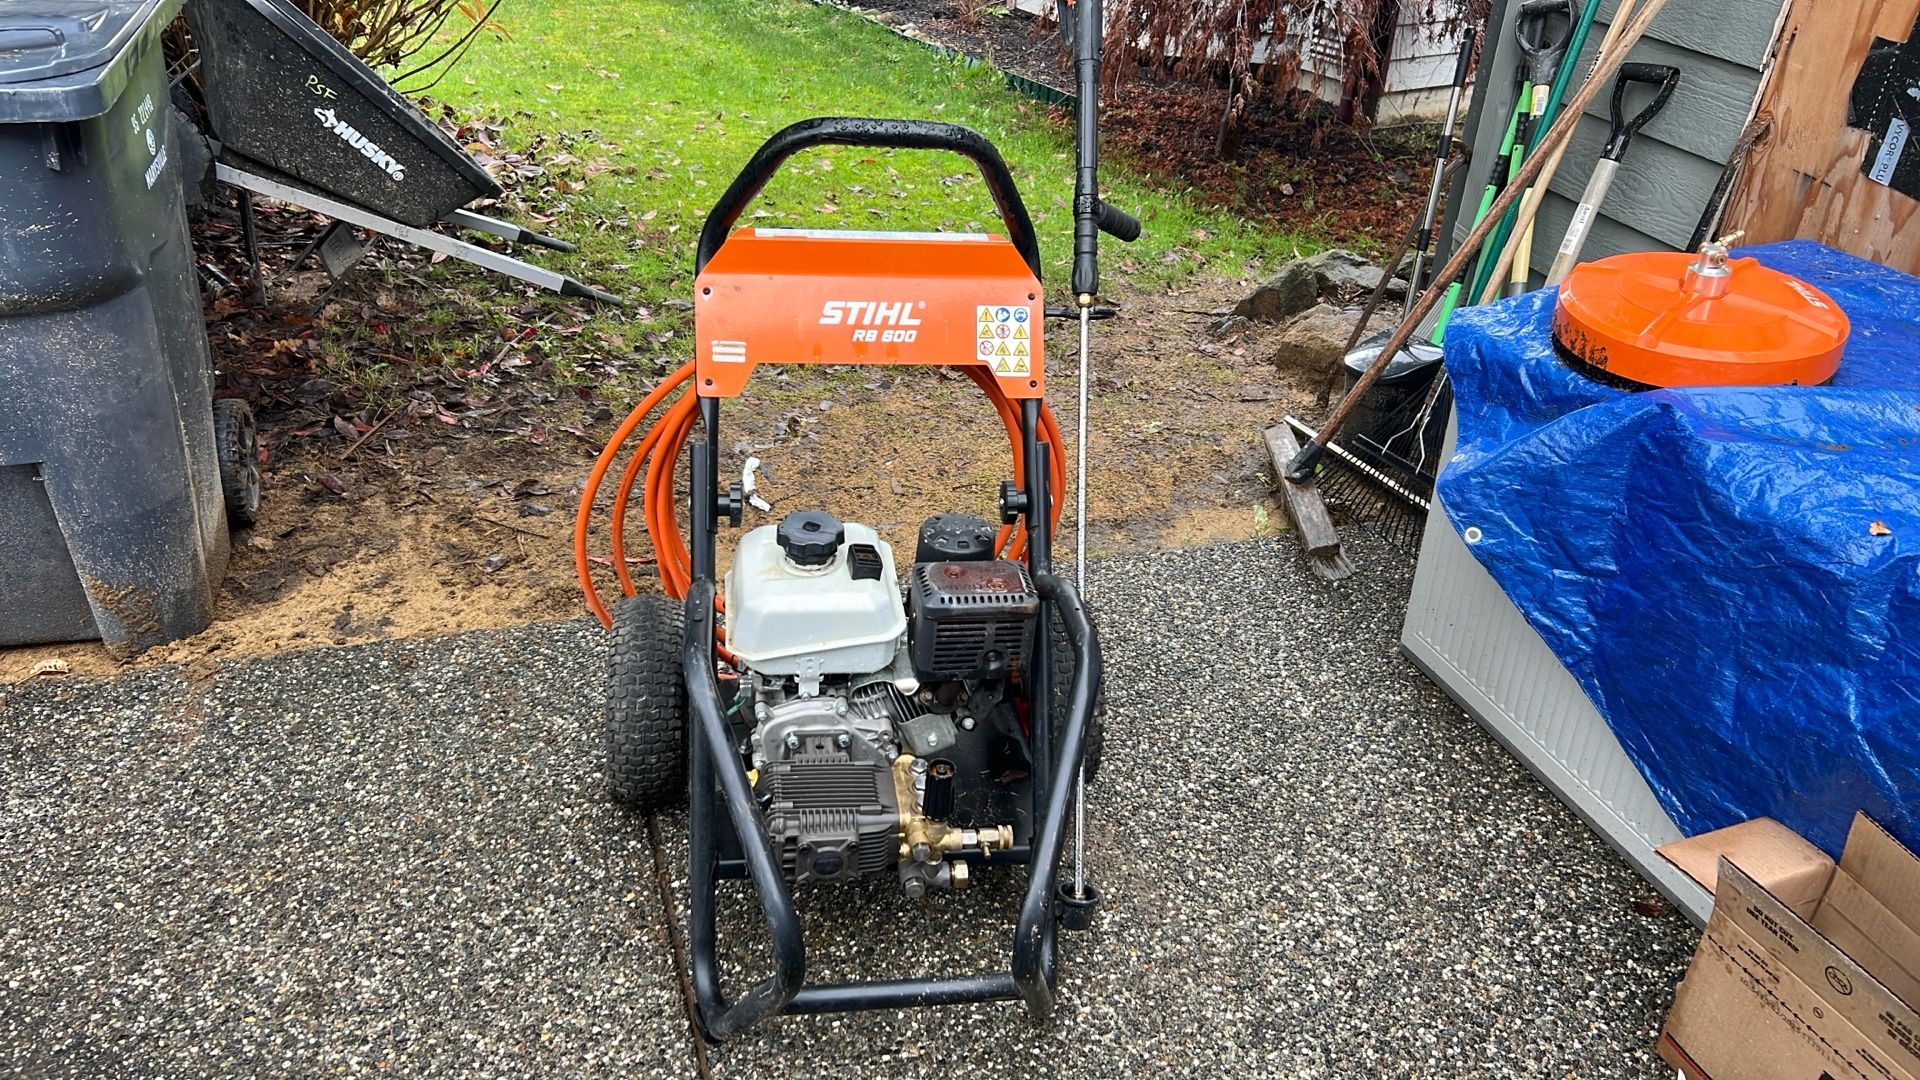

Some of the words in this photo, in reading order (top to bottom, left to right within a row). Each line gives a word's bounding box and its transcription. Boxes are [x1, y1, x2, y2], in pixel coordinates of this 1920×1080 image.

[305, 75, 338, 99] PSF
[333, 120, 405, 175] HUSKY
[1884, 122, 1905, 157] VYCOR
[1875, 162, 1889, 182] PLU
[1784, 280, 1830, 310] STIHL
[818, 300, 922, 326] STIHL
[852, 329, 878, 342] RB
[881, 330, 918, 343] 600
[1753, 904, 1764, 917] DO
[1764, 914, 1778, 928] NOT
[1761, 918, 1778, 937] TEAR
